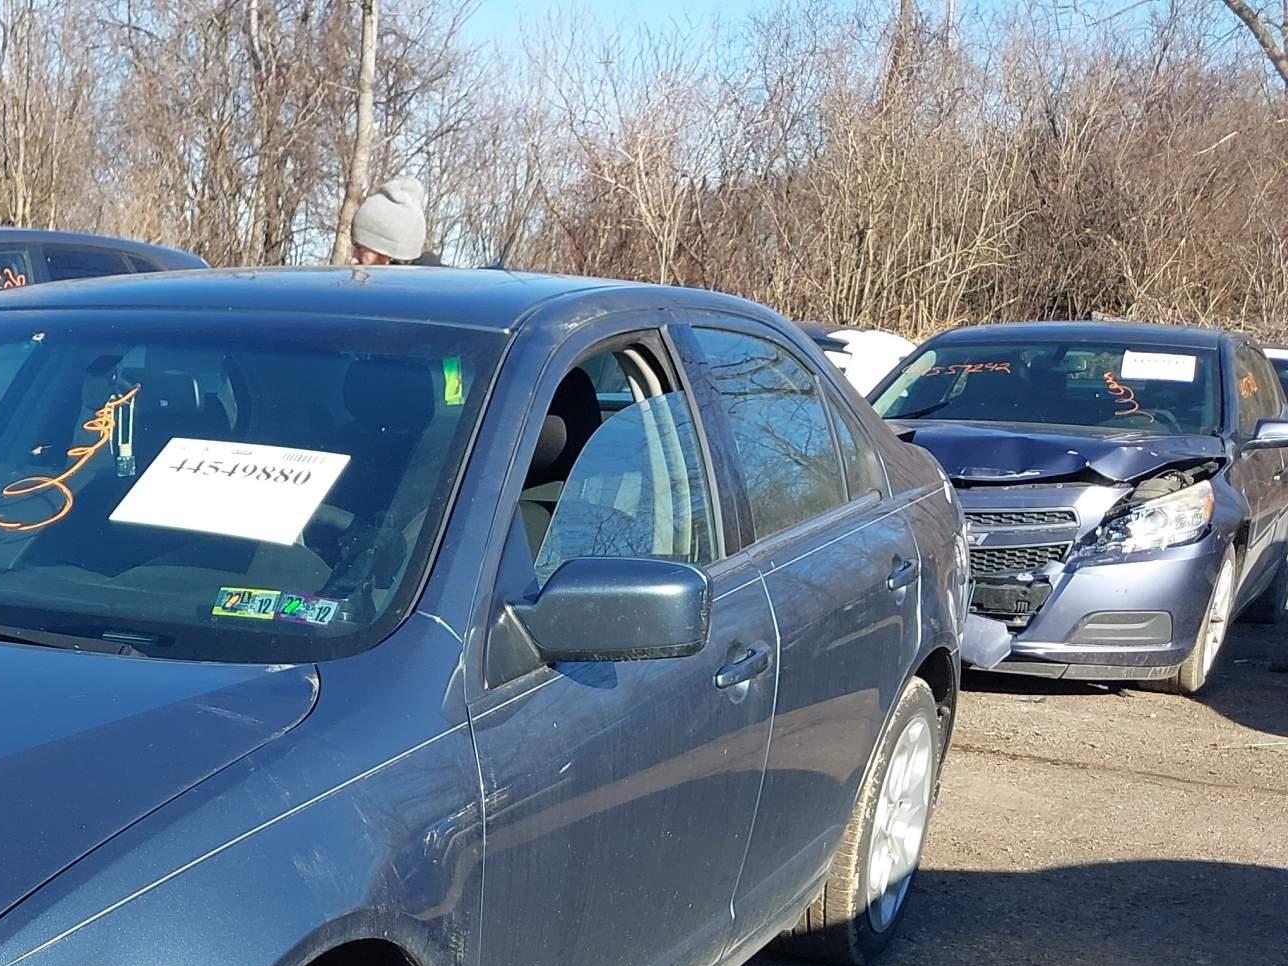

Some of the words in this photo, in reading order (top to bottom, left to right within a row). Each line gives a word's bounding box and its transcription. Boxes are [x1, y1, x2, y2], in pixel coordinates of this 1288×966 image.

[169, 458, 312, 486] 44549880
[257, 598, 273, 615] 12
[314, 606, 331, 622] 12
